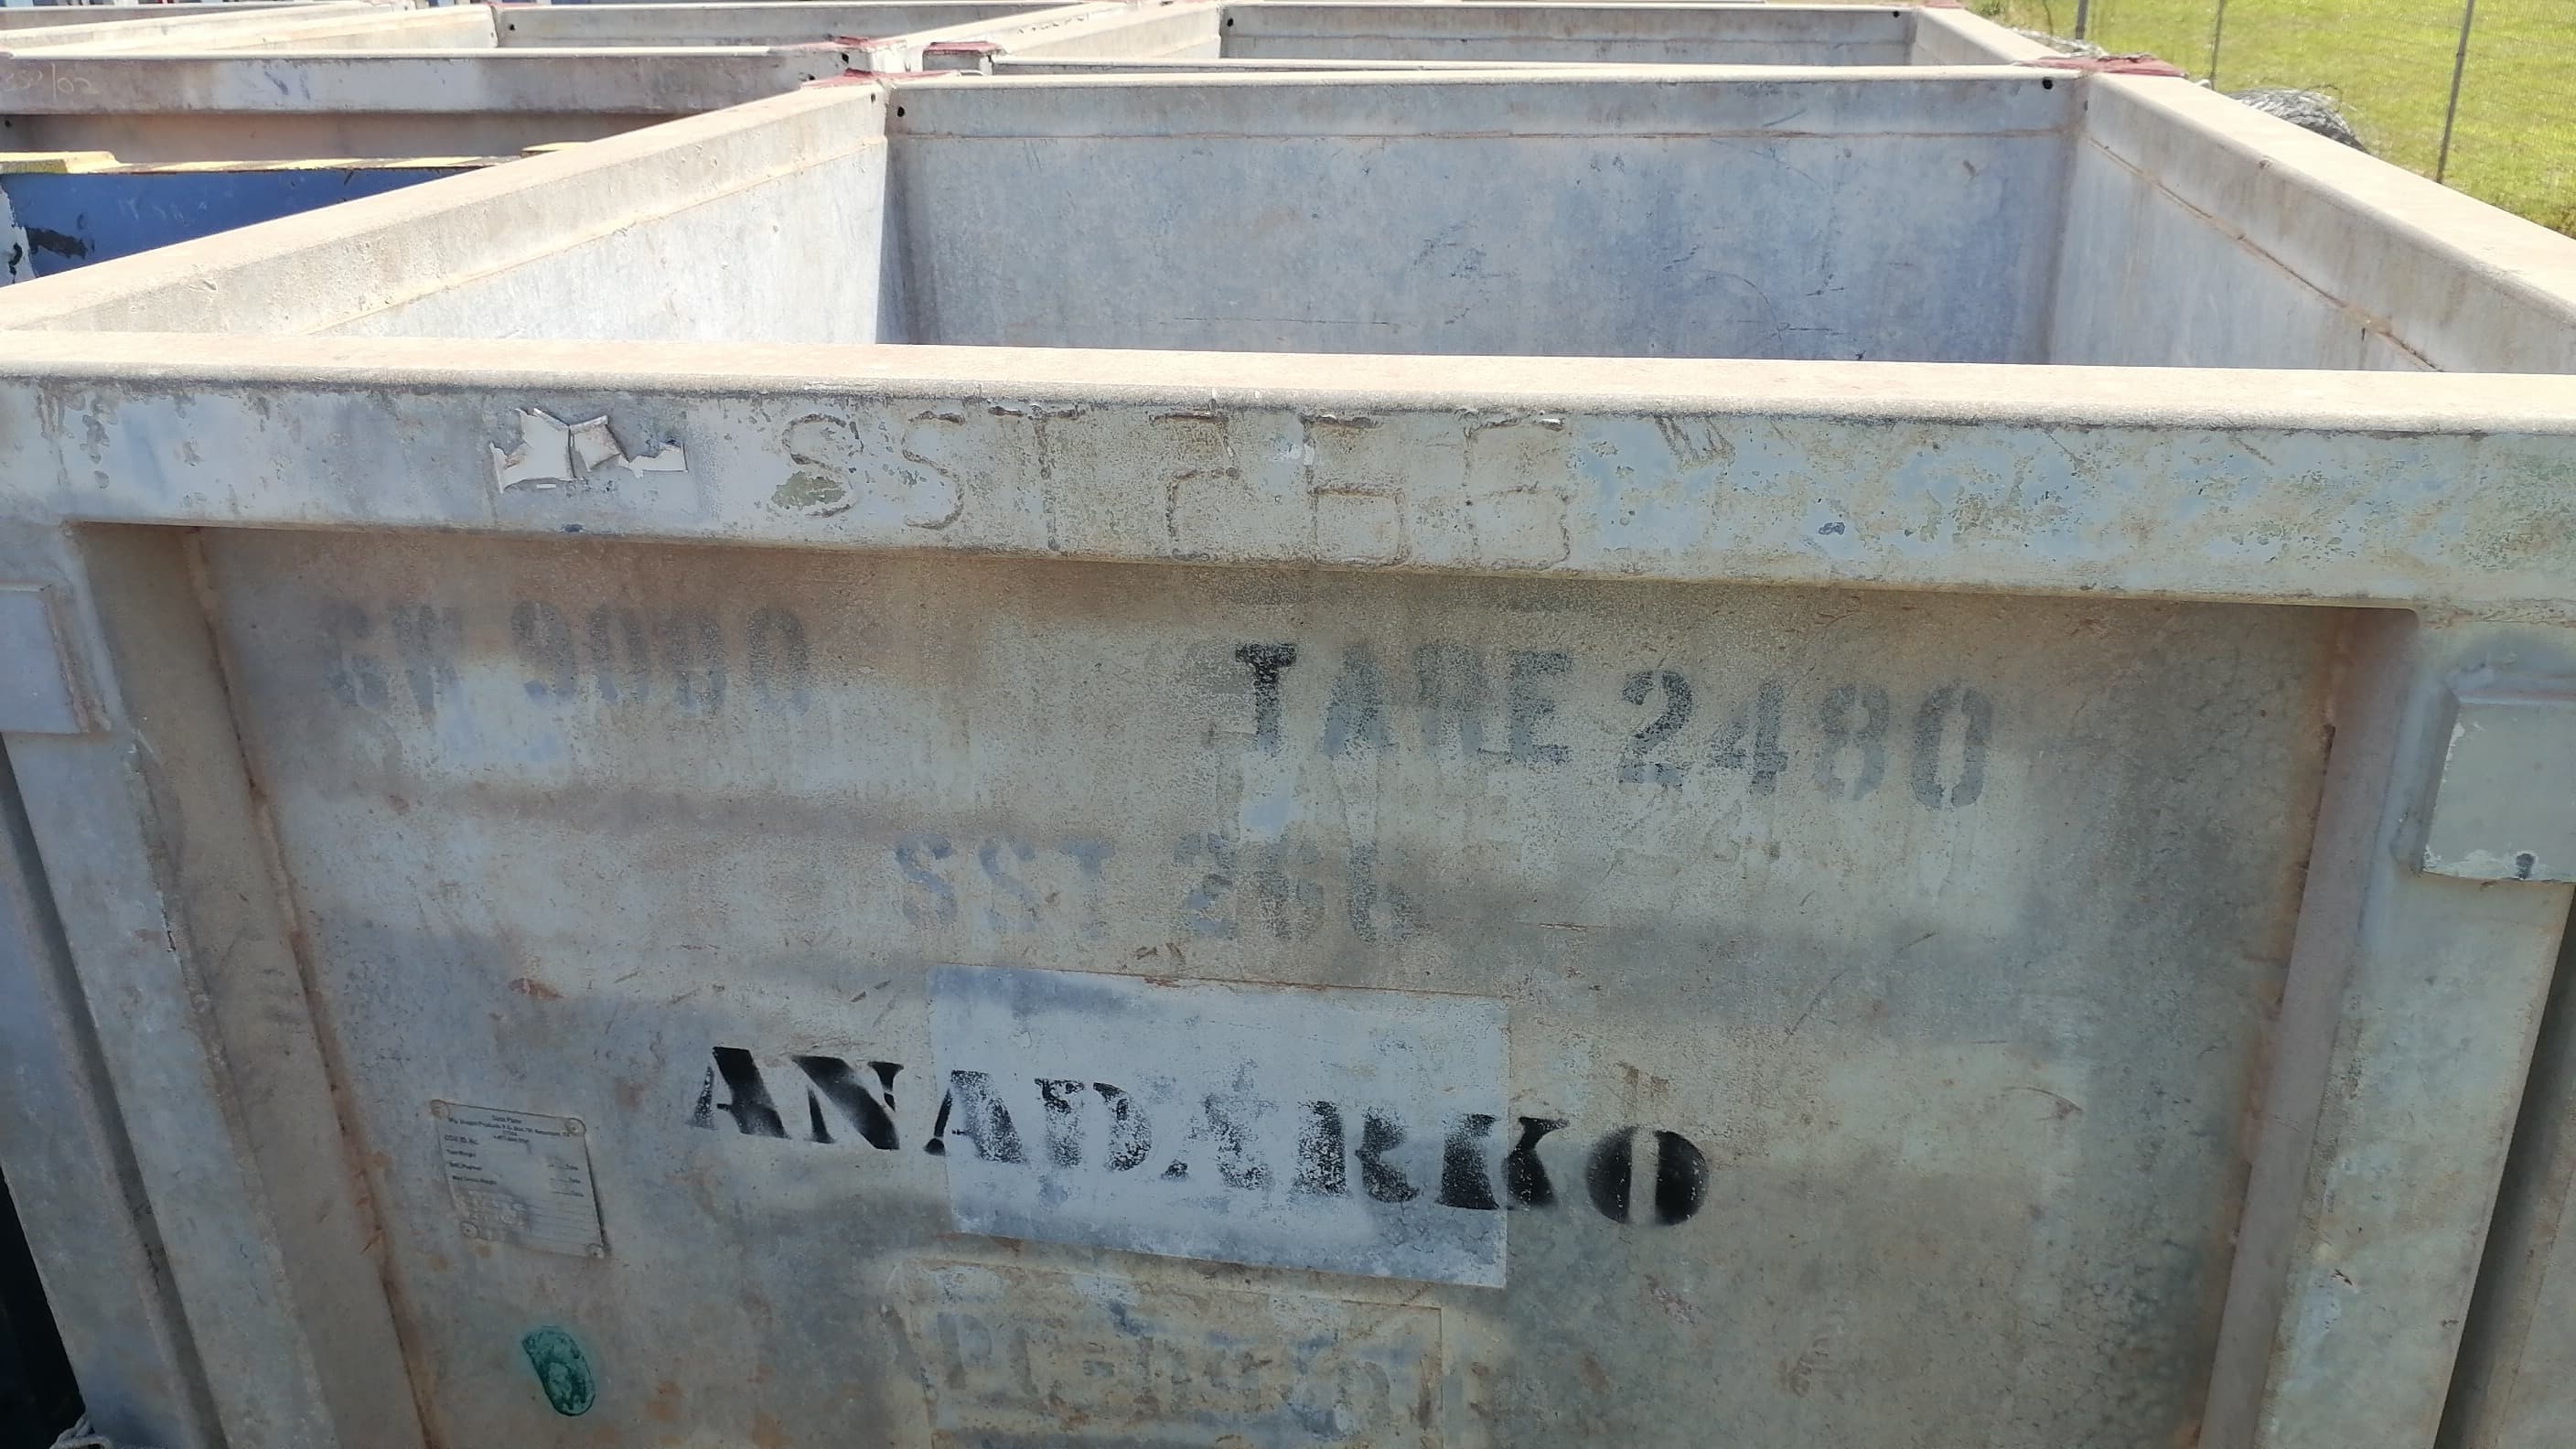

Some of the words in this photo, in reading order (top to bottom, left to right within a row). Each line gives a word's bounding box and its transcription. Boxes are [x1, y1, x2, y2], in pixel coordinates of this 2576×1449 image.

[1234, 641, 1574, 767] TARE
[1619, 669, 1995, 810] 2480
[684, 1045, 1711, 1227] ANADARKO
